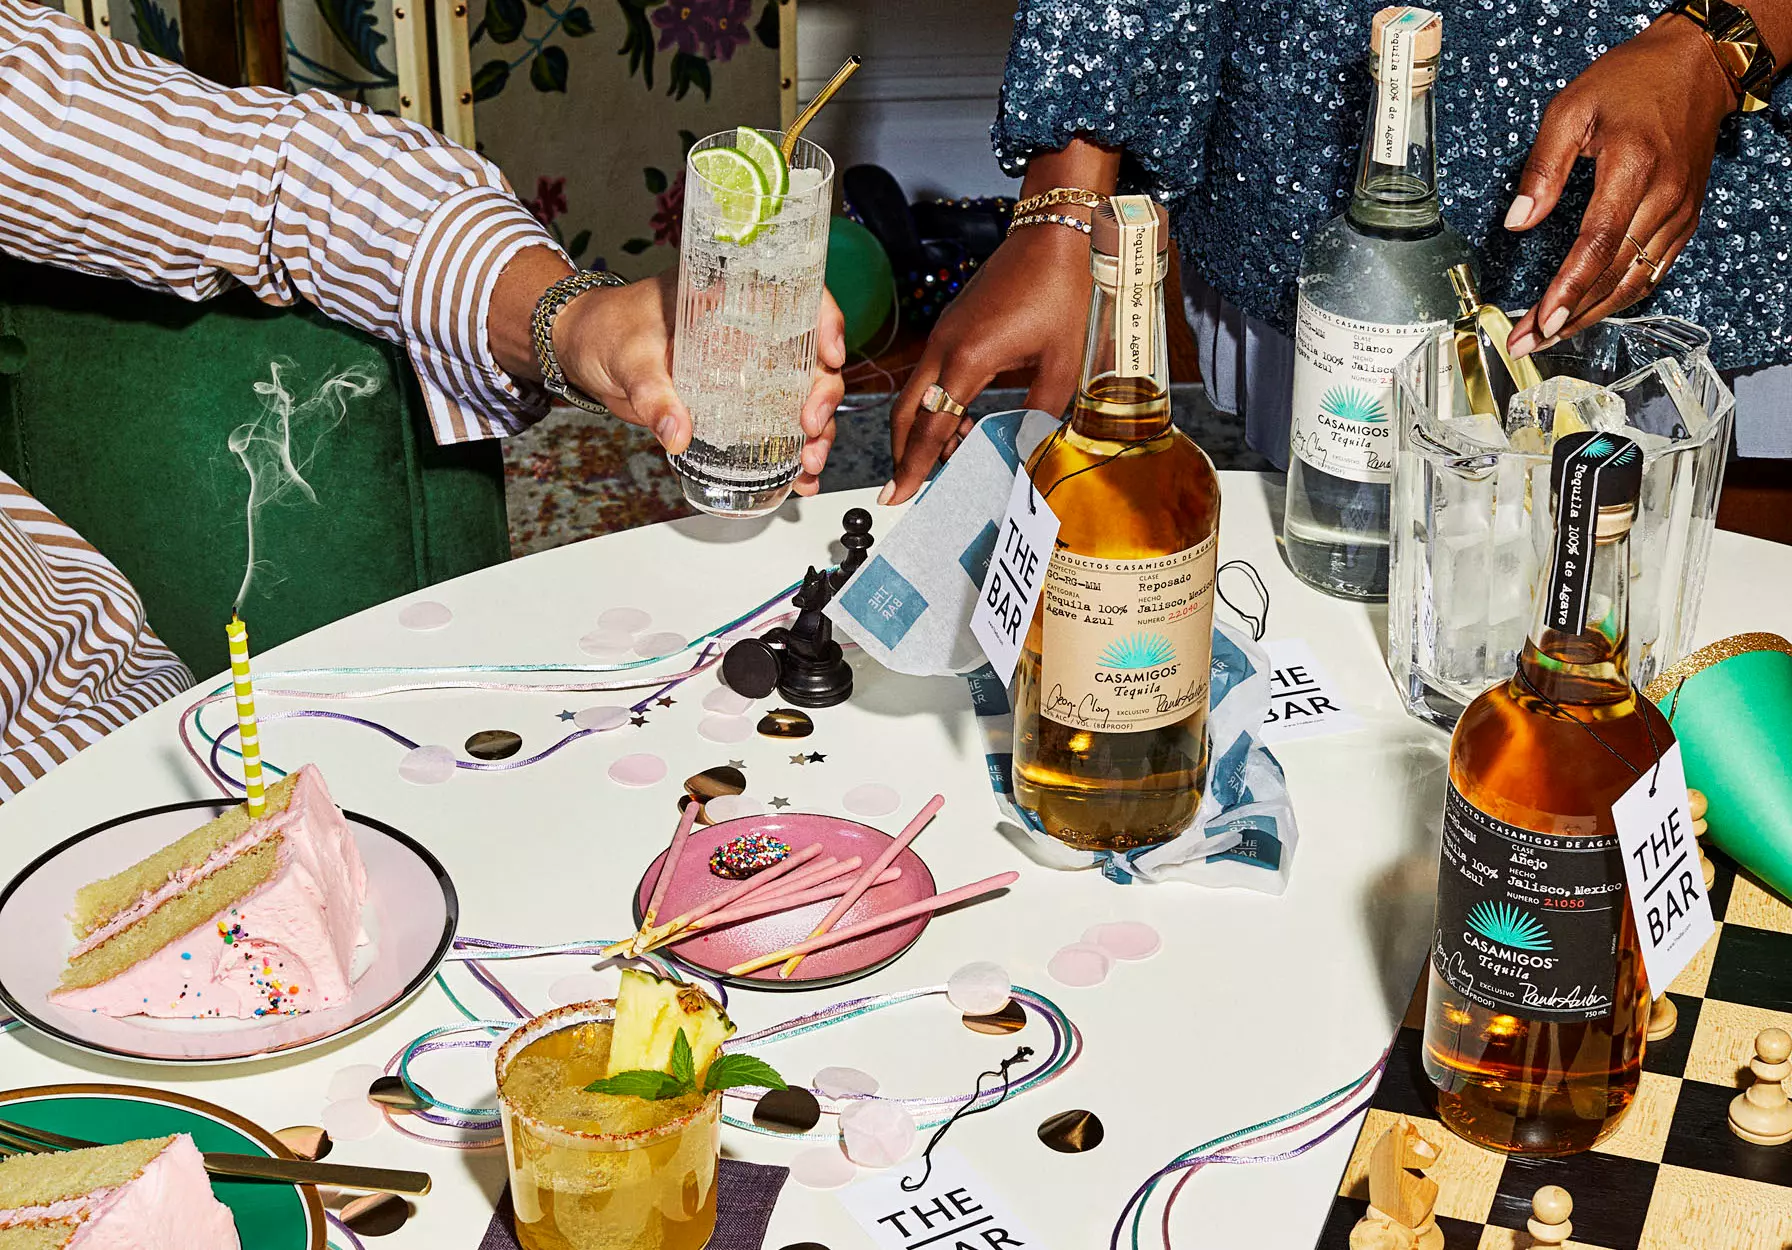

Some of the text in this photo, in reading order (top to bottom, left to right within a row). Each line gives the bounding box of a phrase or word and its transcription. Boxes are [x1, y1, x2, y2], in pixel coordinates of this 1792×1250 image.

[1389, 78, 1399, 102] 100%
[1388, 106, 1398, 119] de
[1385, 126, 1396, 158] Agave
[1130, 226, 1146, 371] Tequila 100% de Agave
[1335, 319, 1391, 334] CASAMIGOS
[1396, 327, 1408, 335] DE
[1352, 341, 1394, 354] Blanco
[1313, 359, 1333, 374] Azul
[1322, 350, 1345, 367] 100%
[1317, 414, 1390, 438] CASAMIGOS
[1331, 431, 1372, 449] Tequila
[1005, 517, 1039, 589] THE
[1558, 463, 1588, 626] Tequila 100% de Agave
[1116, 558, 1178, 571] CASAMIGOS
[1182, 553, 1192, 561] DE
[1138, 573, 1192, 593] Reposado
[1139, 574, 1159, 582] CLASE
[1046, 590, 1128, 615] Tequila 100%
[1137, 579, 1213, 614] Jalisco, Mexico
[1138, 595, 1162, 604] HECHO
[986, 571, 1022, 646] BAR
[1046, 602, 1114, 626] Agave Azul
[1138, 603, 1199, 625] NUMERO 22040
[1094, 664, 1178, 684] CASAMIGOS
[1210, 660, 1229, 678] AR
[1270, 665, 1315, 688] HE
[969, 679, 982, 692] HE
[1114, 683, 1161, 700] Tequila
[1117, 708, 1150, 716] EXCLUSIVO
[1106, 722, 1134, 731] PROOF)
[1240, 839, 1258, 847] HE
[1489, 822, 1559, 848] CASAMIGOS
[1566, 840, 1581, 849] DE
[1587, 838, 1620, 849] AGAV
[1633, 807, 1684, 882] THE
[1511, 843, 1534, 856] CLASE
[1471, 858, 1499, 879] 100%
[1509, 853, 1548, 871] Añejo
[1460, 864, 1485, 887] Azul
[1509, 867, 1536, 880] HECHO
[1507, 875, 1622, 897] Jalisco, Mexico
[1506, 890, 1585, 909] NUMERO 21050
[1647, 870, 1700, 948] BAR
[1463, 931, 1554, 970] CASAMIGOS
[1479, 954, 1531, 981] Tequila
[1469, 991, 1496, 1009] PROOF)
[1479, 981, 1516, 999] EXCLUSIVO
[1584, 1011, 1598, 1019] 750
[876, 1187, 984, 1239] THE
